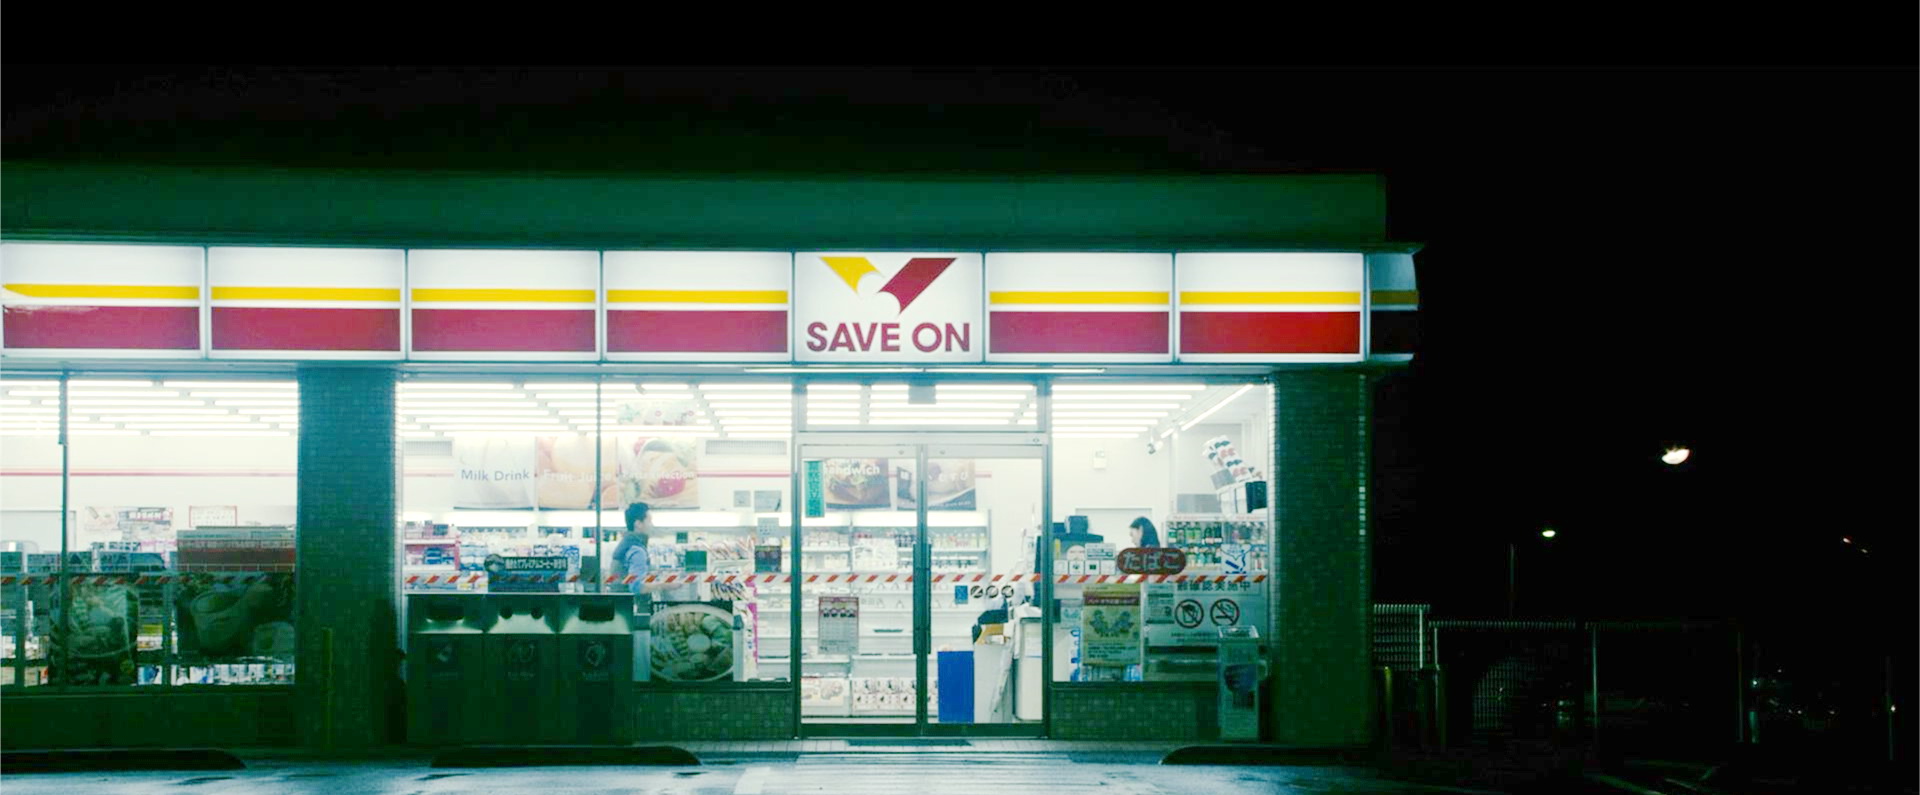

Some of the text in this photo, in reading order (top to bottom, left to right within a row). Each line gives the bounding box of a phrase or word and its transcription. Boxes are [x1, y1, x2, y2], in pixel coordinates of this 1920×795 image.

[807, 321, 970, 353] SAVE ON
[461, 468, 530, 481] Milk Drink
[1123, 551, 1181, 570] たばこ
